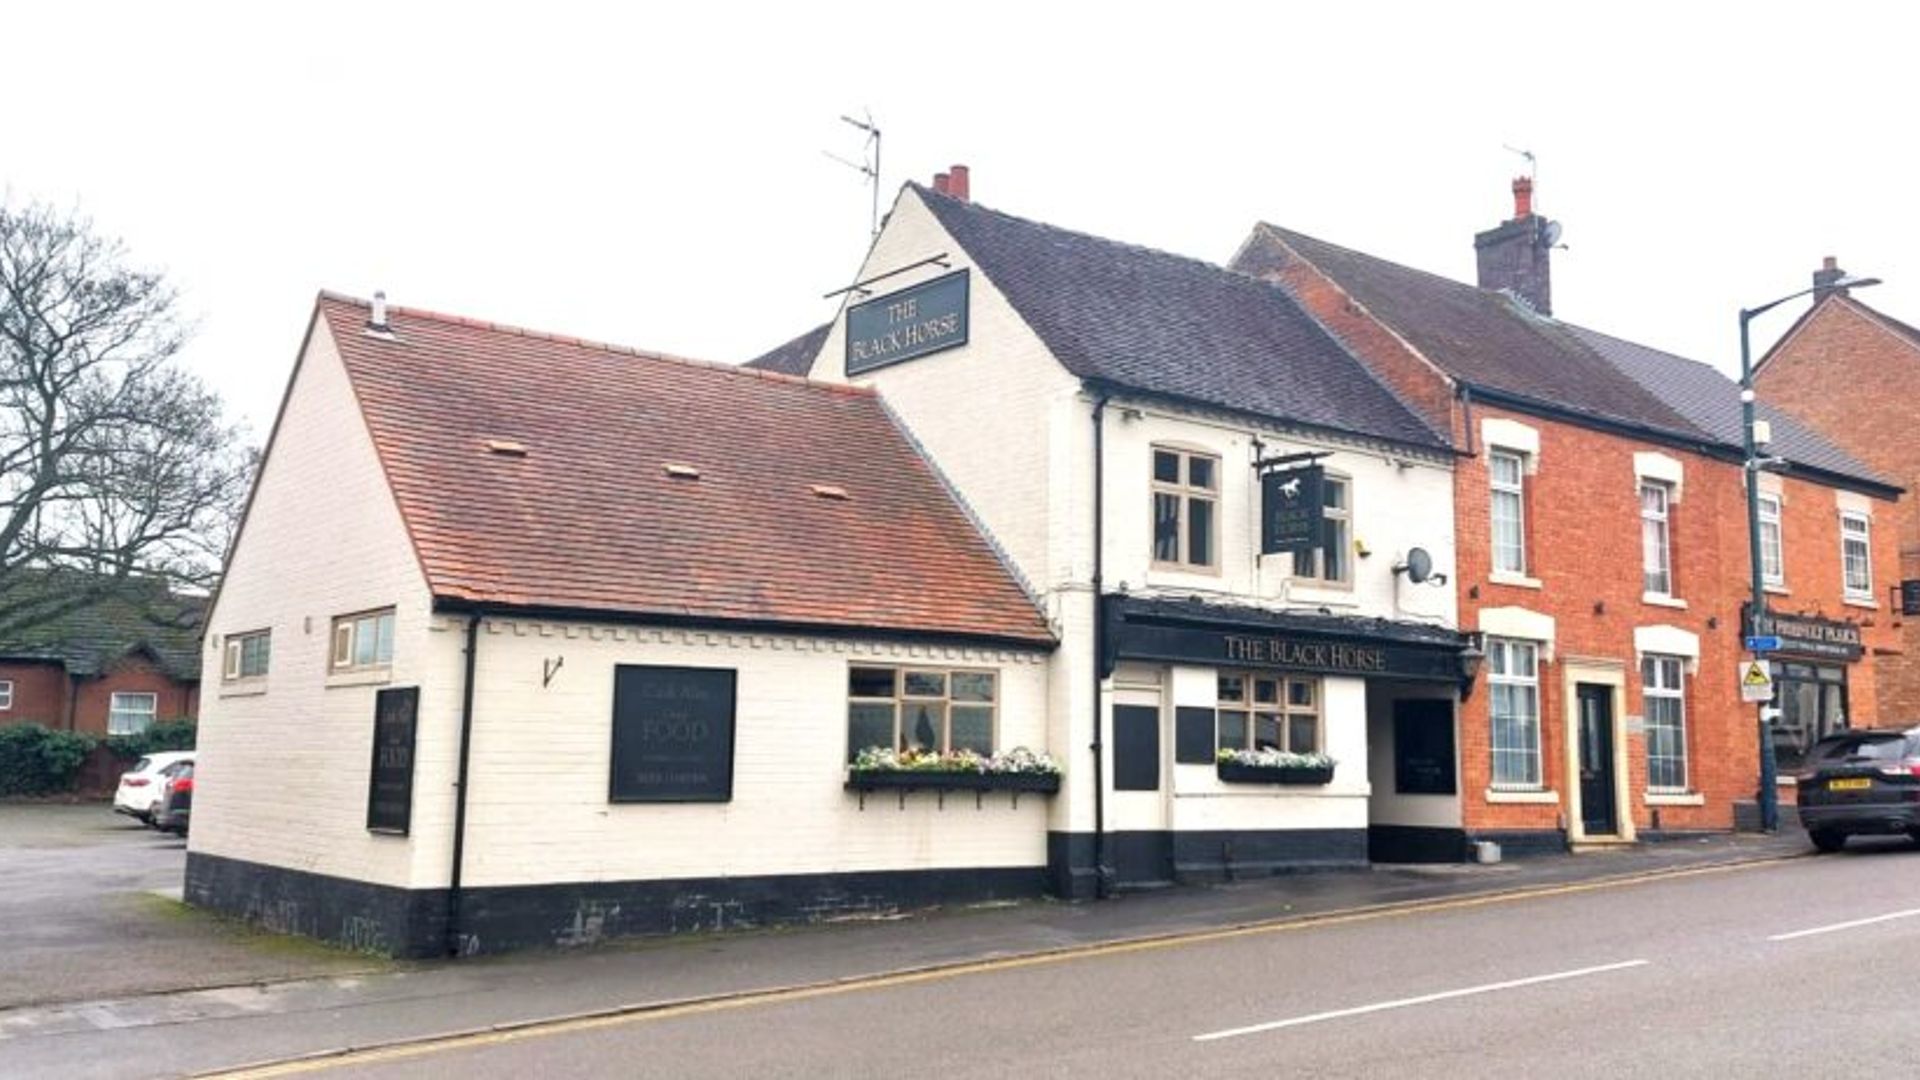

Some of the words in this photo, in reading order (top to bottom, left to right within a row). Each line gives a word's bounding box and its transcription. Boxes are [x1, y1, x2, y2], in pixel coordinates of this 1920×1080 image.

[888, 299, 917, 323] THE
[852, 327, 901, 361] BLACK
[905, 313, 959, 347] HORSE
[1224, 635, 1264, 661] THE
[1269, 639, 1326, 666] BLACK
[1331, 644, 1386, 670] HORSE
[641, 718, 710, 742] FOOD
